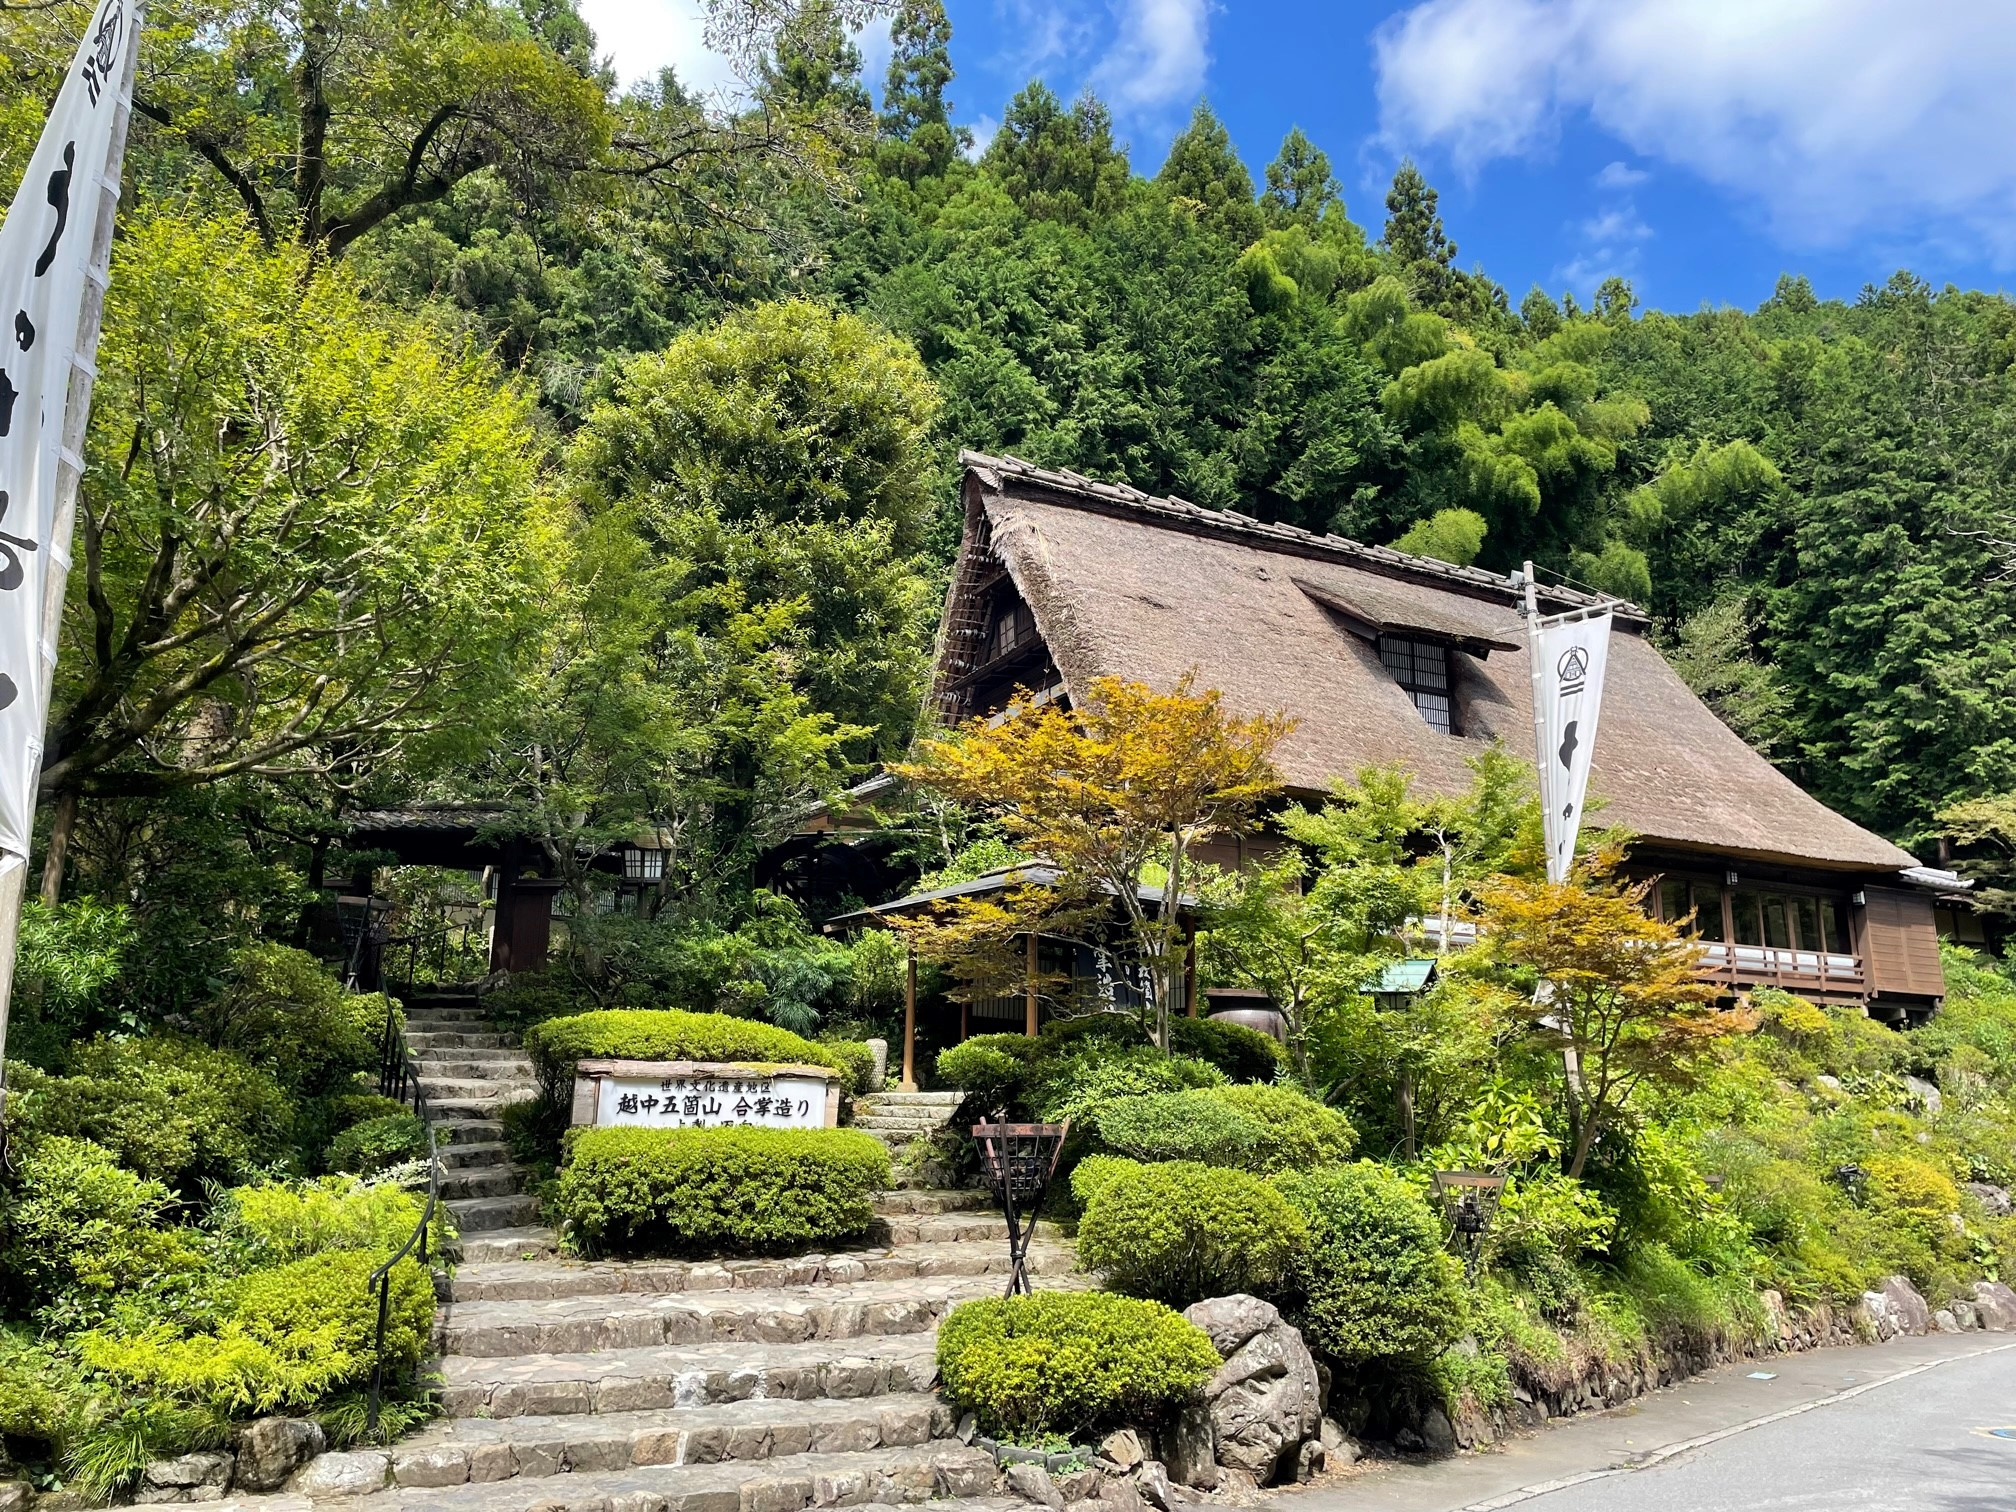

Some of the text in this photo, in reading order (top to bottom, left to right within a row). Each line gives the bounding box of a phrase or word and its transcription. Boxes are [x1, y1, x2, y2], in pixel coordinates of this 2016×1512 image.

[660, 1079, 771, 1093] 世界文化遺産地区
[616, 1094, 809, 1117] 越中五箇山 合掌造り
